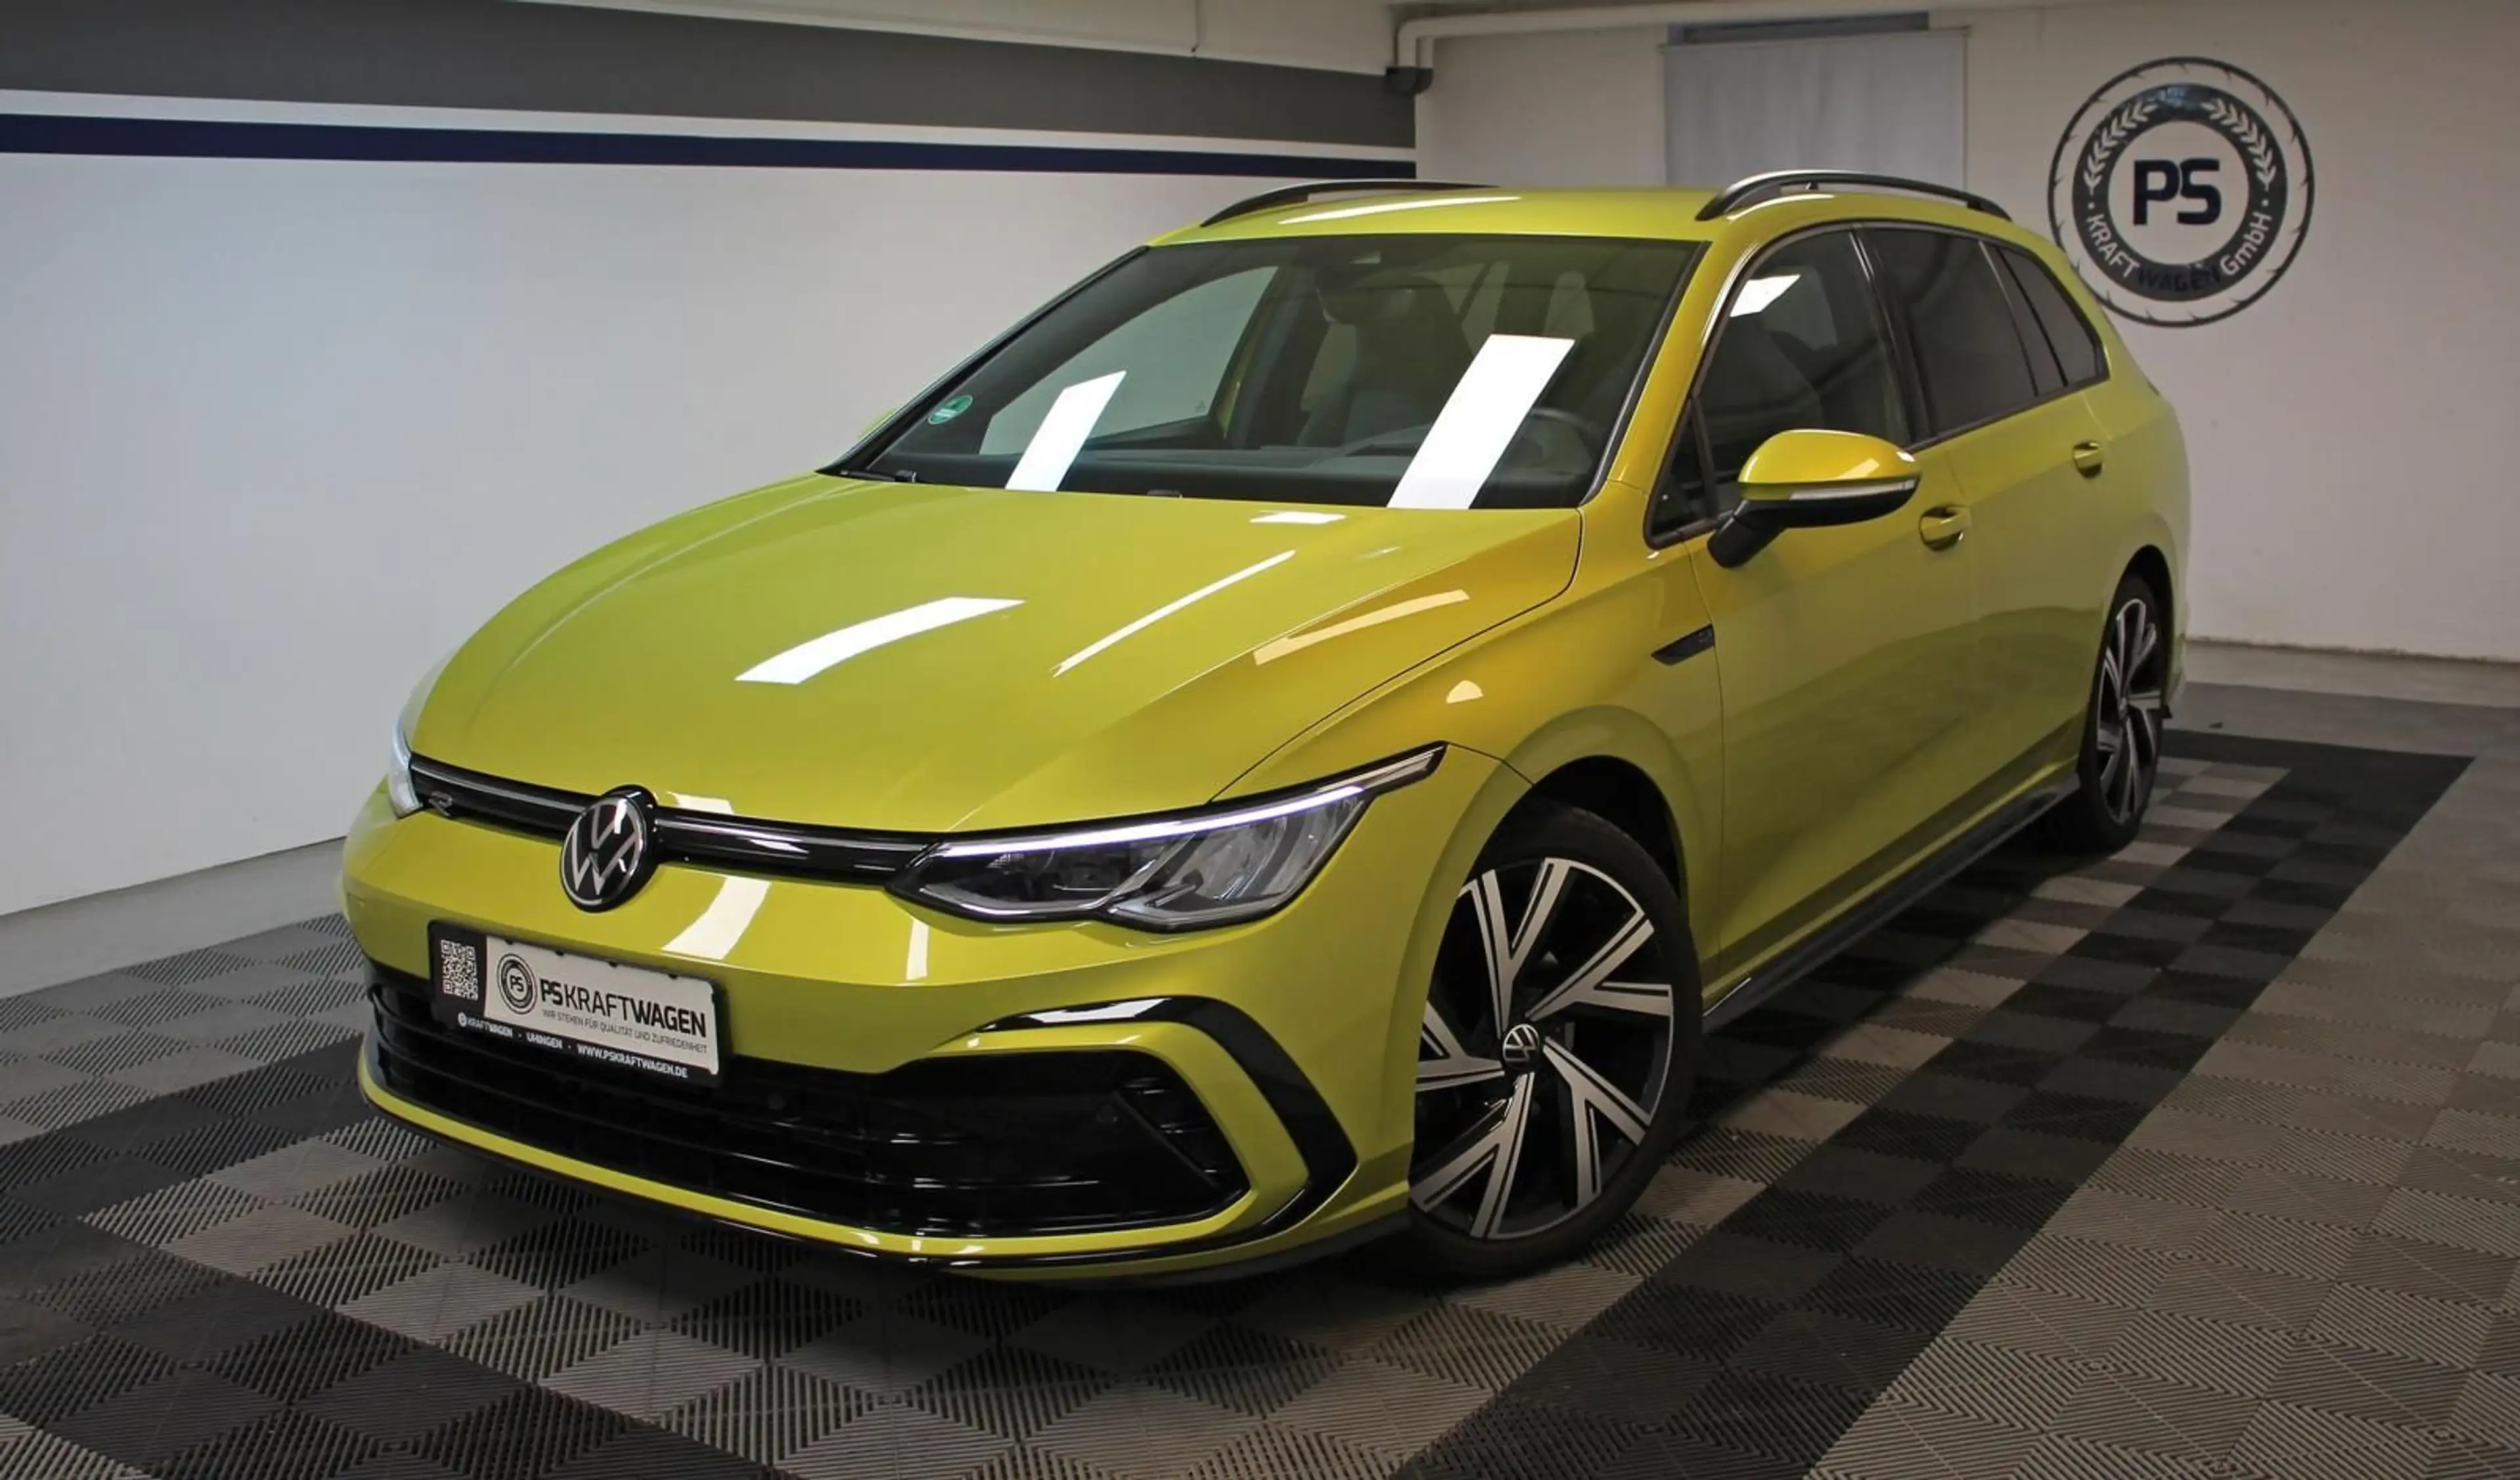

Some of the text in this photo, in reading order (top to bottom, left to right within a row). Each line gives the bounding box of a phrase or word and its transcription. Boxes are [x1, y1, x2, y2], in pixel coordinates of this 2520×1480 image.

[2133, 158, 2221, 226] PS
[2220, 211, 2273, 276] GmbH
[510, 975, 524, 992] PS
[557, 1012, 584, 1027] STEHEN
[584, 1018, 598, 1030] FÜR
[634, 1029, 651, 1041] UND
[652, 1032, 707, 1054] ZUFRIEDENHEIT
